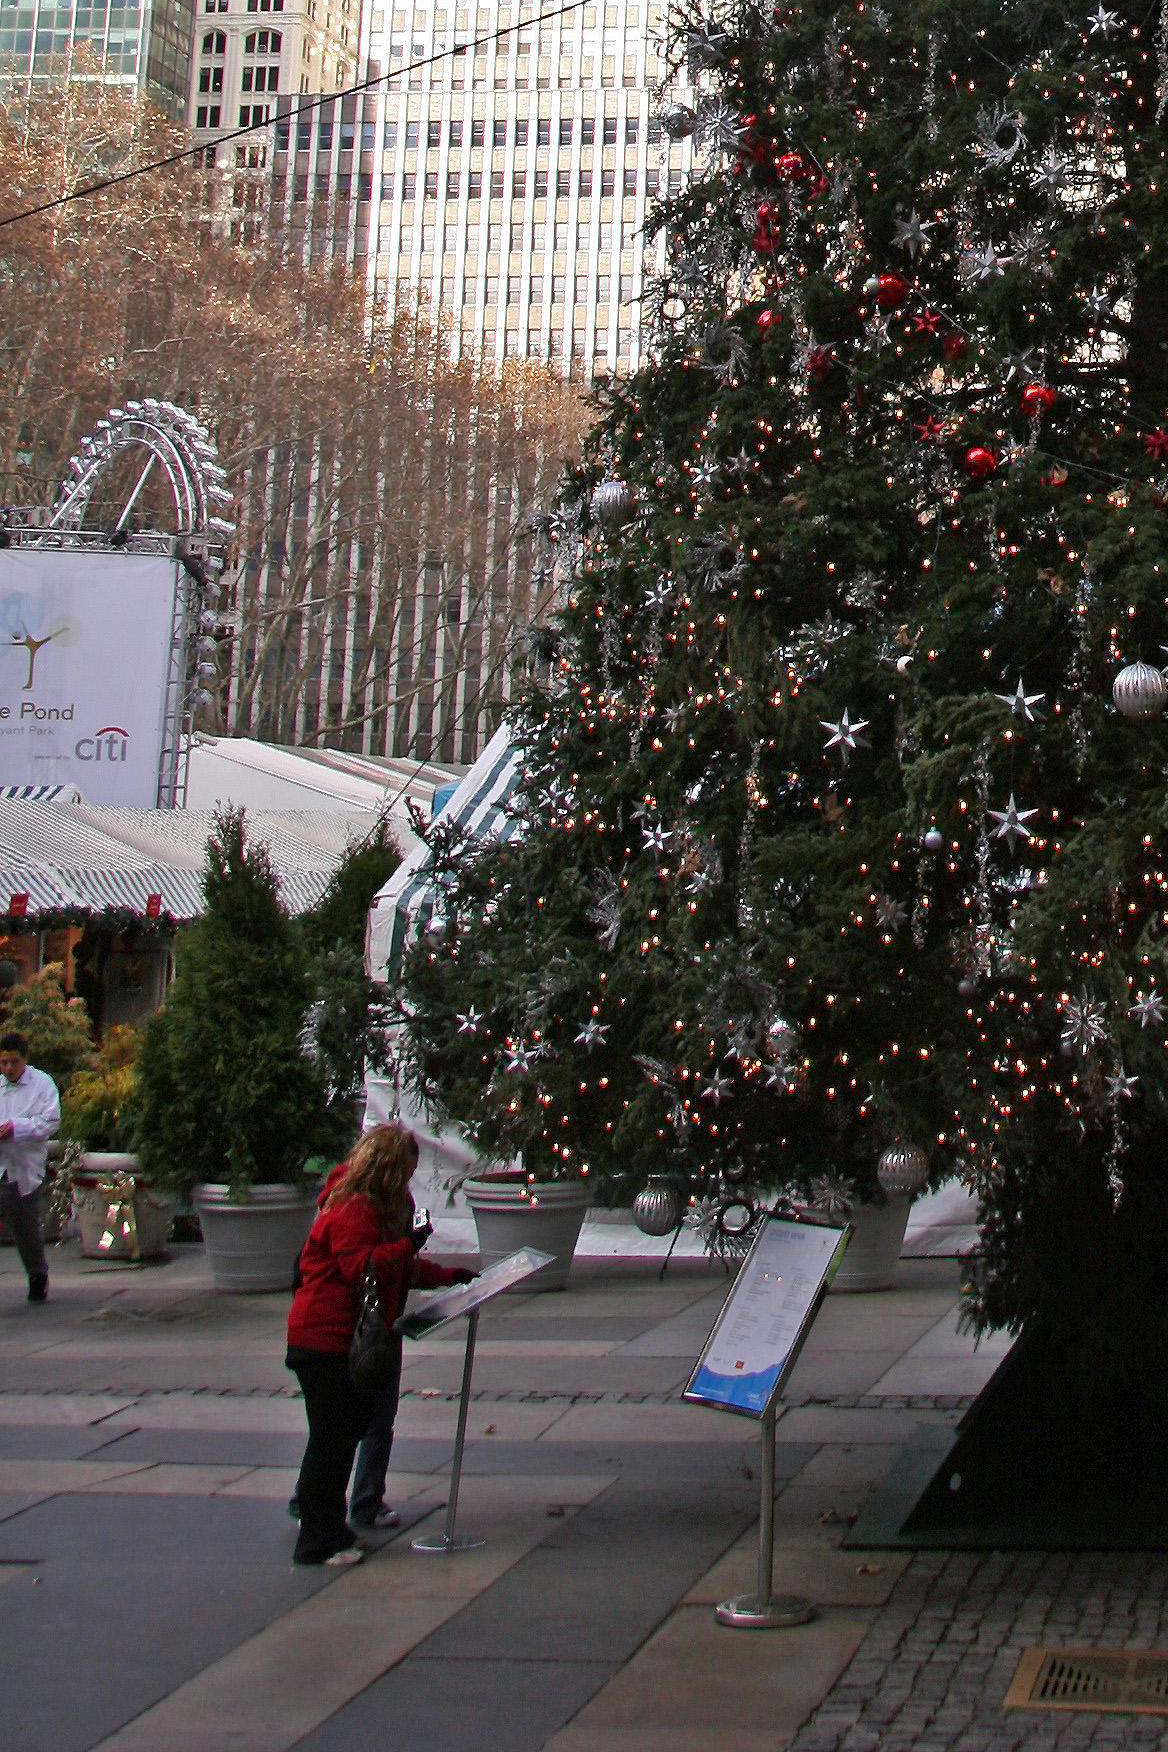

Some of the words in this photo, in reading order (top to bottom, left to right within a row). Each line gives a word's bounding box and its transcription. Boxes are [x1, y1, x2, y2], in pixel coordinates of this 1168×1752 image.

[20, 702, 74, 720] Pond
[28, 725, 55, 736] Park
[75, 729, 128, 761] citi
